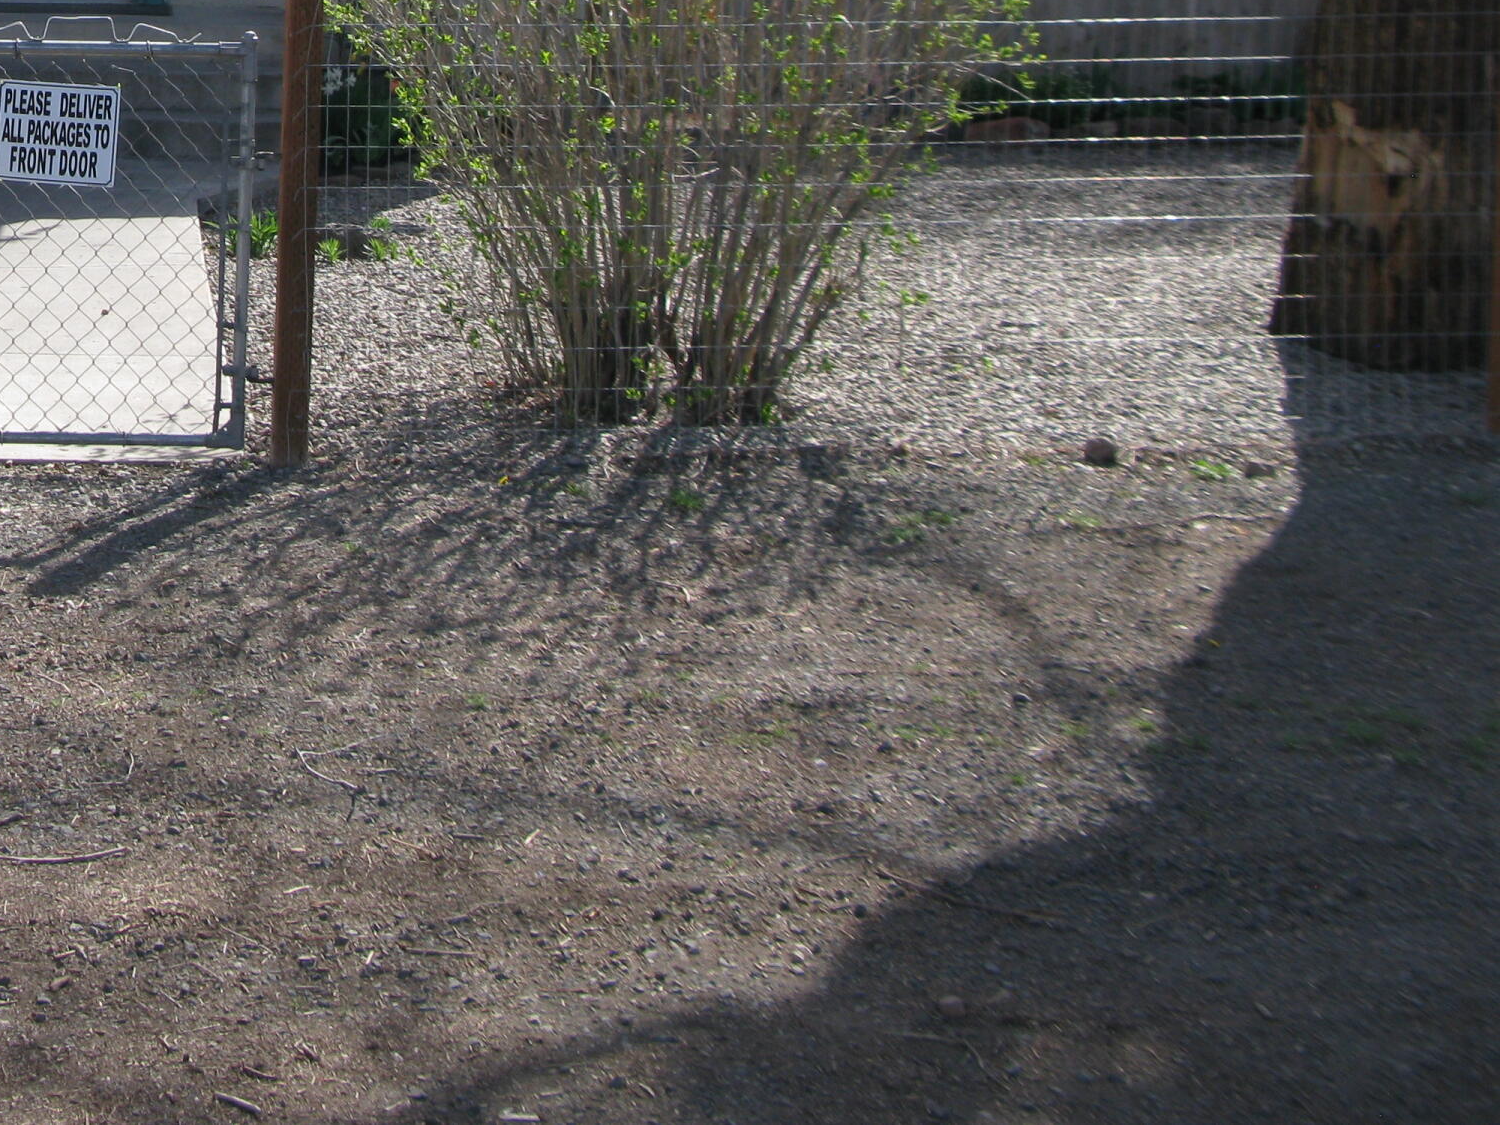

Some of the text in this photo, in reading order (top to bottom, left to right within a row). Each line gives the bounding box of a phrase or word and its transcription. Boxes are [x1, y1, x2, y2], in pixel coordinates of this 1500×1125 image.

[4, 88, 113, 120] PLEASE DELIVER
[1, 117, 110, 149] ALL PACKAGES TO
[9, 146, 98, 178] FRONT DOOR
